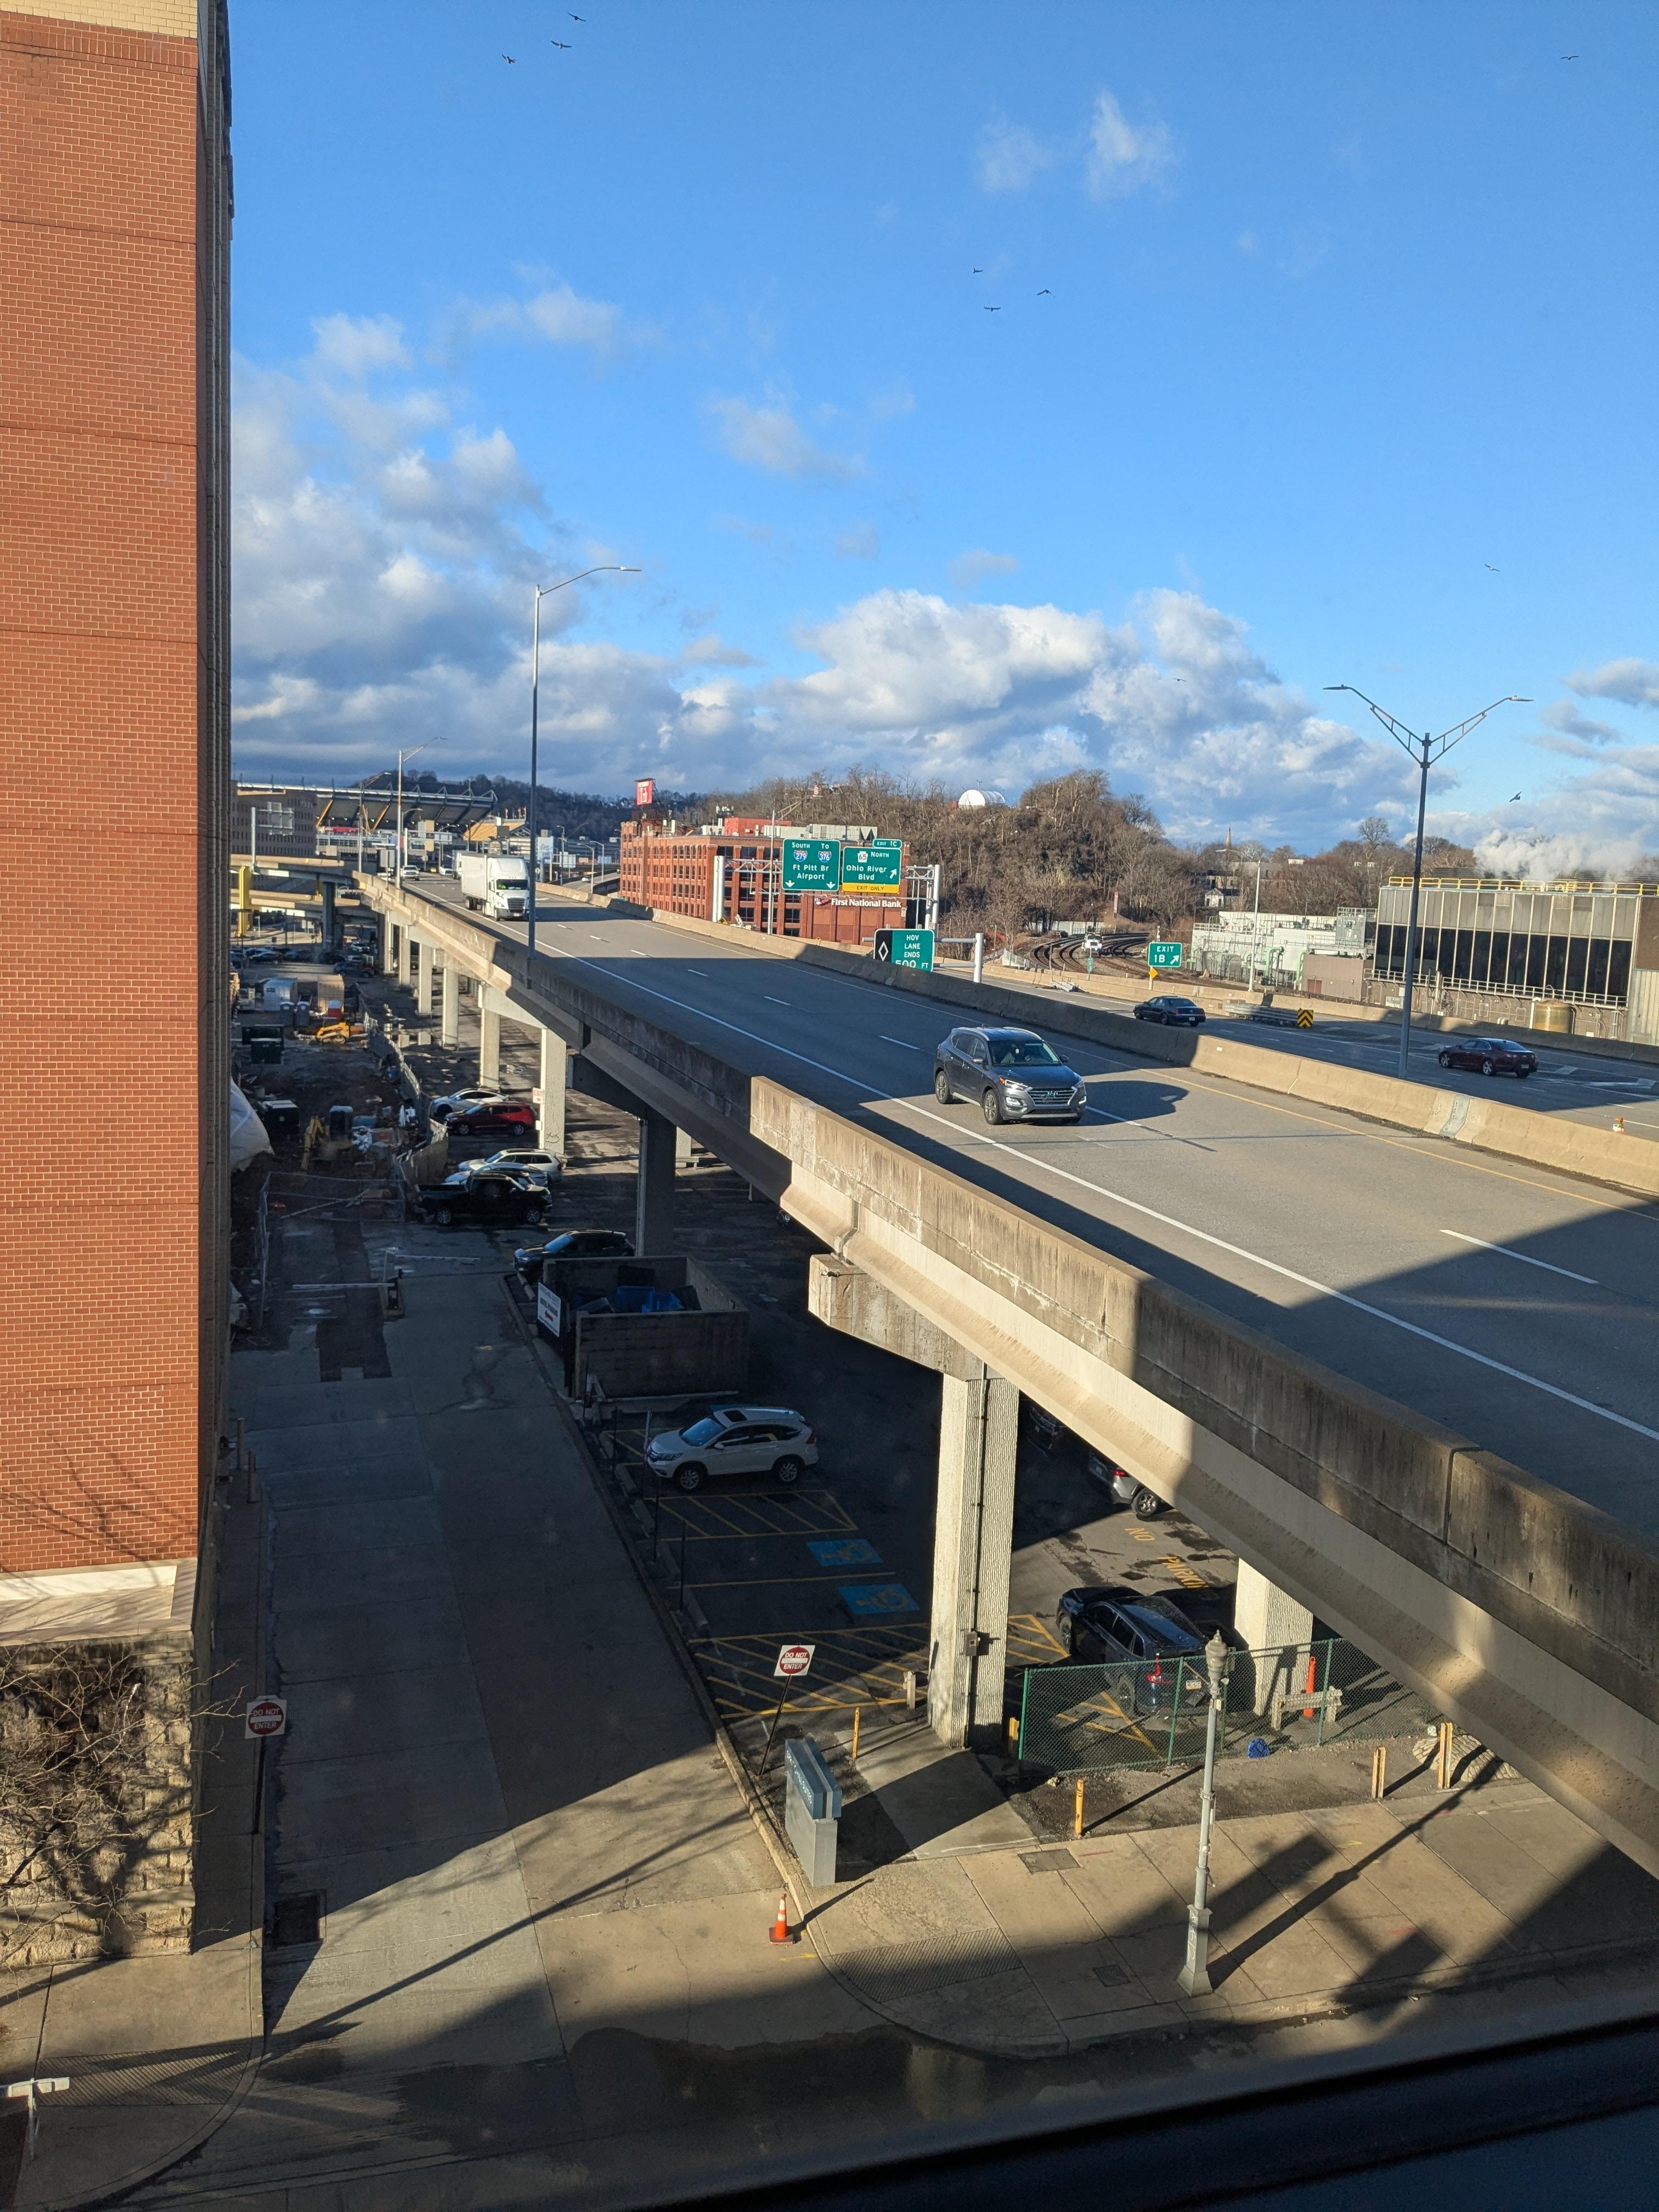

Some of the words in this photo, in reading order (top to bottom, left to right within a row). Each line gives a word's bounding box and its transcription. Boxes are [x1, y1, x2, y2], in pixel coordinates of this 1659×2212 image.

[797, 872, 825, 881] Airport
[831, 898, 848, 906] First
[849, 899, 881, 907] National
[1154, 954, 1165, 963] 1B
[1125, 1527, 1156, 1541] NO
[254, 1722, 276, 1730] ENTER
